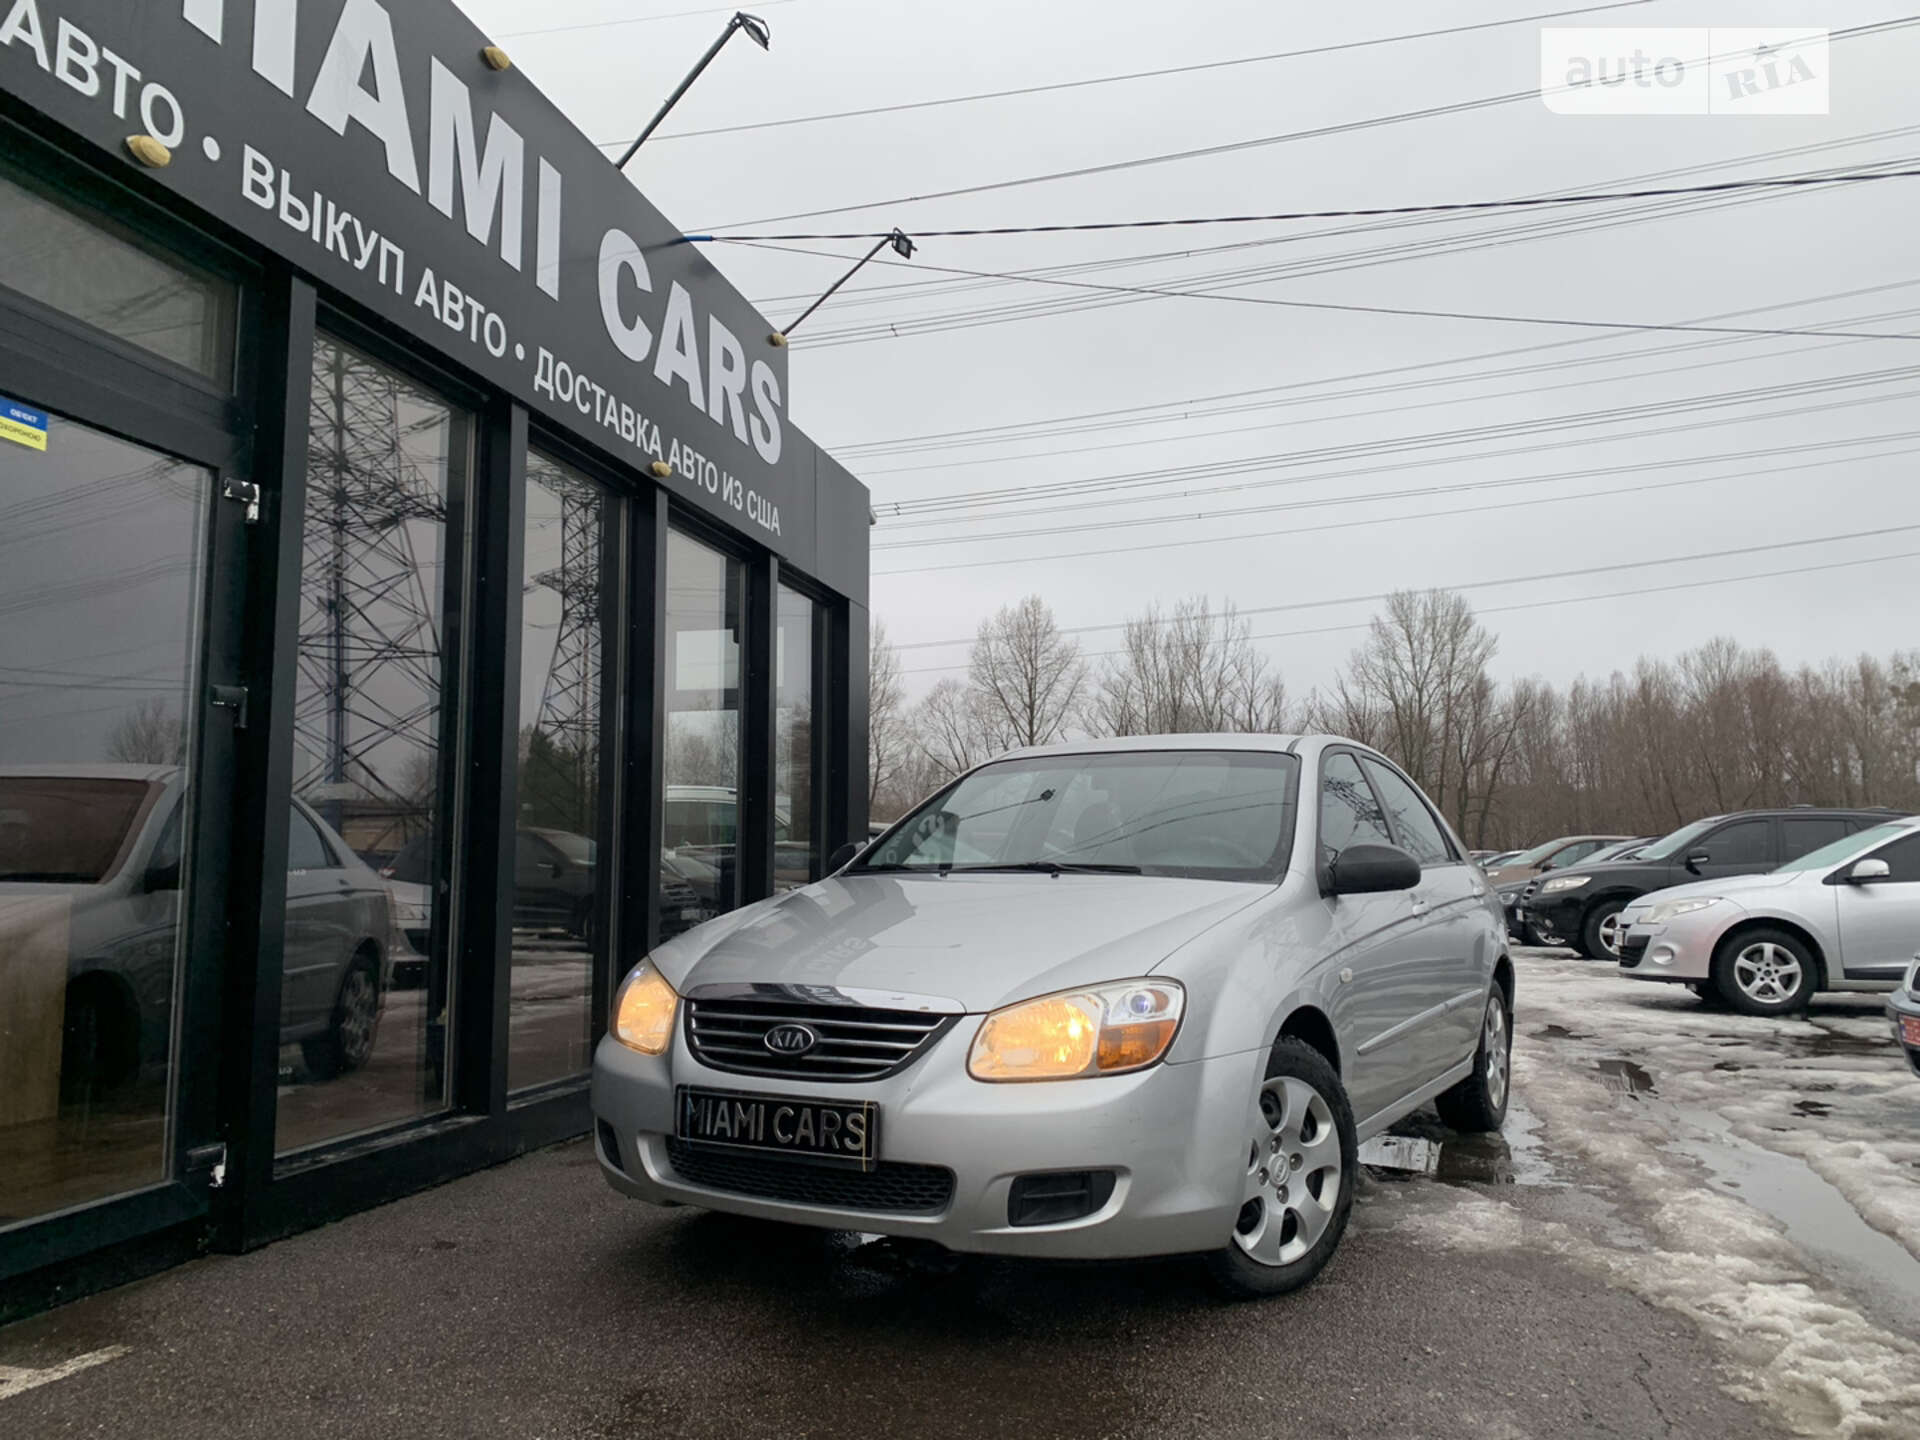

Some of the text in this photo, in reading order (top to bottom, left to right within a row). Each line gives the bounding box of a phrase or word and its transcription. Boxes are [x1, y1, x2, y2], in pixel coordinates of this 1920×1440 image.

[0, 0, 782, 537] АВТО ВЫКУП АВТО ДОСТАВКА АВТО ИЗ США
[598, 228, 782, 465] CARS
[770, 1031, 805, 1048] KIA
[688, 1096, 865, 1151] MIAMI CARS
